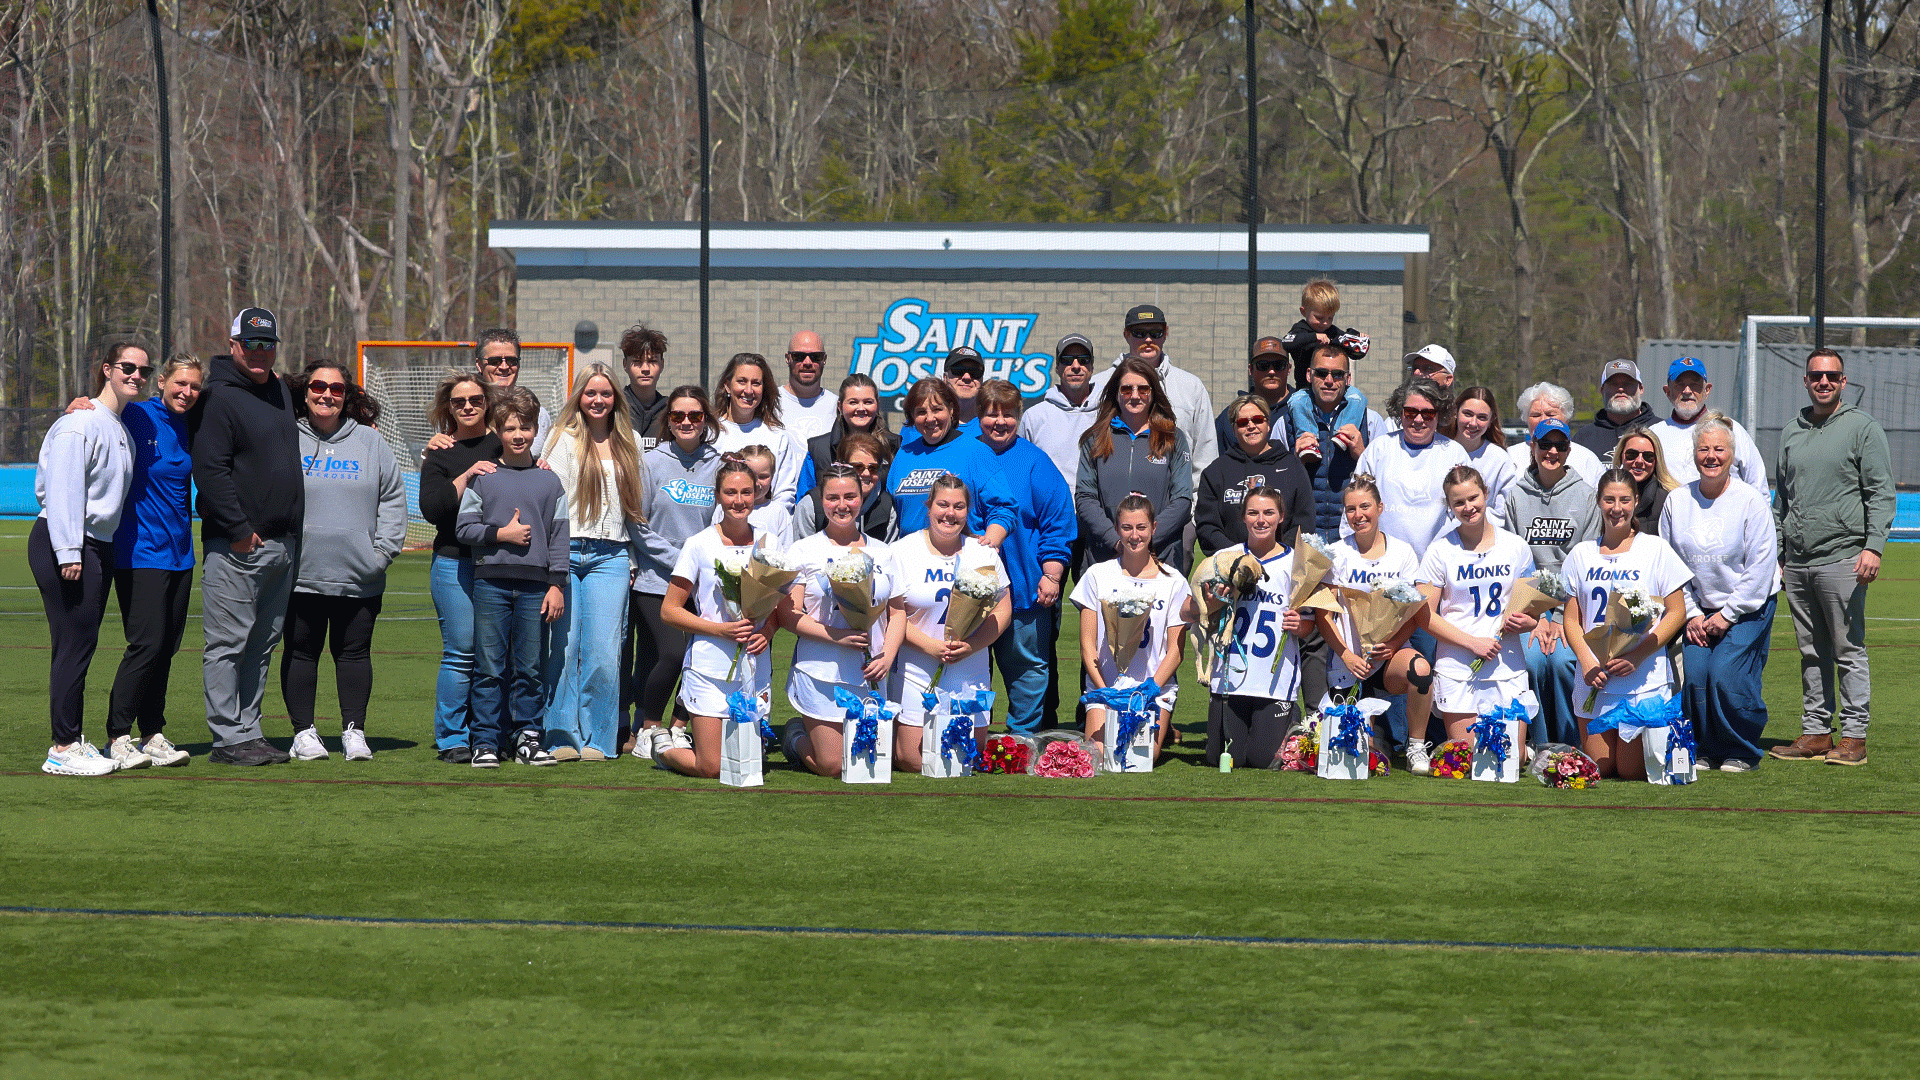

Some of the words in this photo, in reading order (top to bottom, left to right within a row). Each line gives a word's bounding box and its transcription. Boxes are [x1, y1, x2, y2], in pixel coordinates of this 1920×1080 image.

[883, 304, 1028, 353] SAINT
[855, 343, 1047, 392] JOSH'S
[324, 456, 359, 471] JOE'S
[308, 471, 359, 480] ACROSSE
[911, 470, 941, 479] SAINT
[896, 478, 936, 493] JOSEPH
[1532, 518, 1568, 530] SAINT
[1527, 528, 1573, 544] JOSEPH'S
[1456, 563, 1510, 581] MONKS
[1585, 566, 1640, 581] MONKS
[1245, 590, 1283, 605] ONKS
[1469, 582, 1502, 617] 18
[1229, 607, 1276, 658] 25
